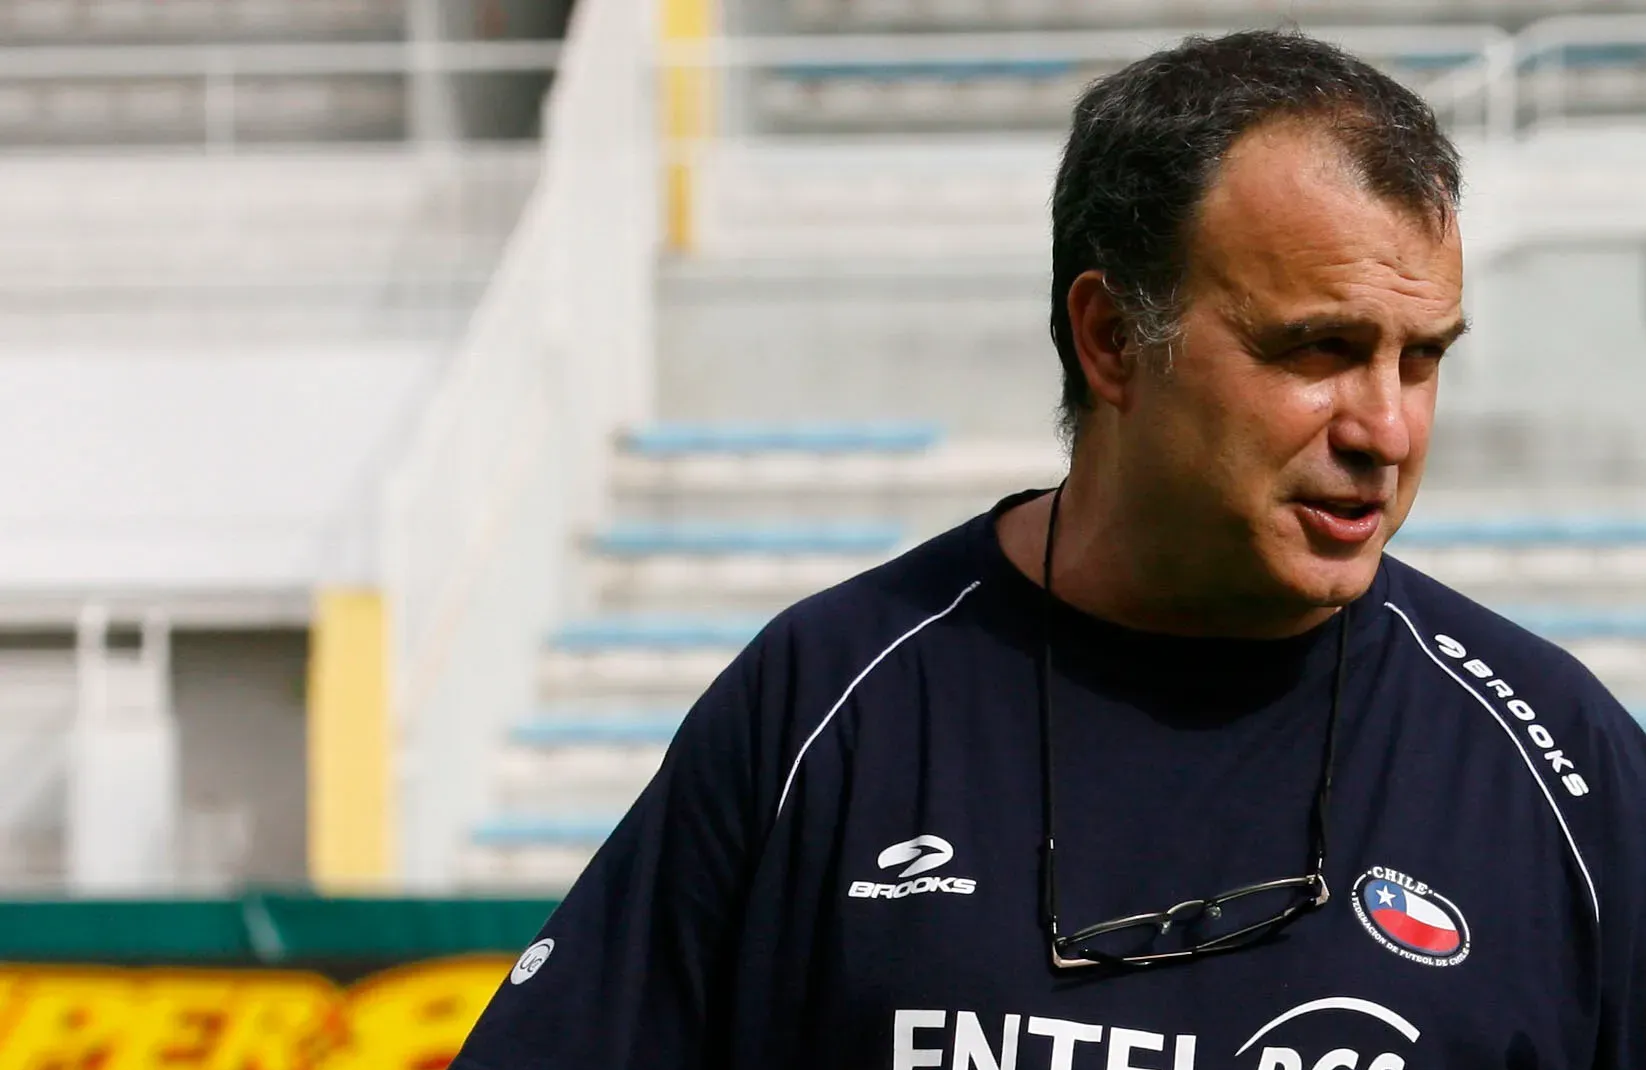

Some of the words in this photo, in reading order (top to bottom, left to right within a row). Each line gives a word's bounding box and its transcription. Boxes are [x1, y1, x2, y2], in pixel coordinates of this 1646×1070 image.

[1463, 659, 1589, 796] BROOKS
[848, 876, 977, 899] BROOKS
[1372, 866, 1428, 895] CHILE
[1386, 942, 1399, 954] DE
